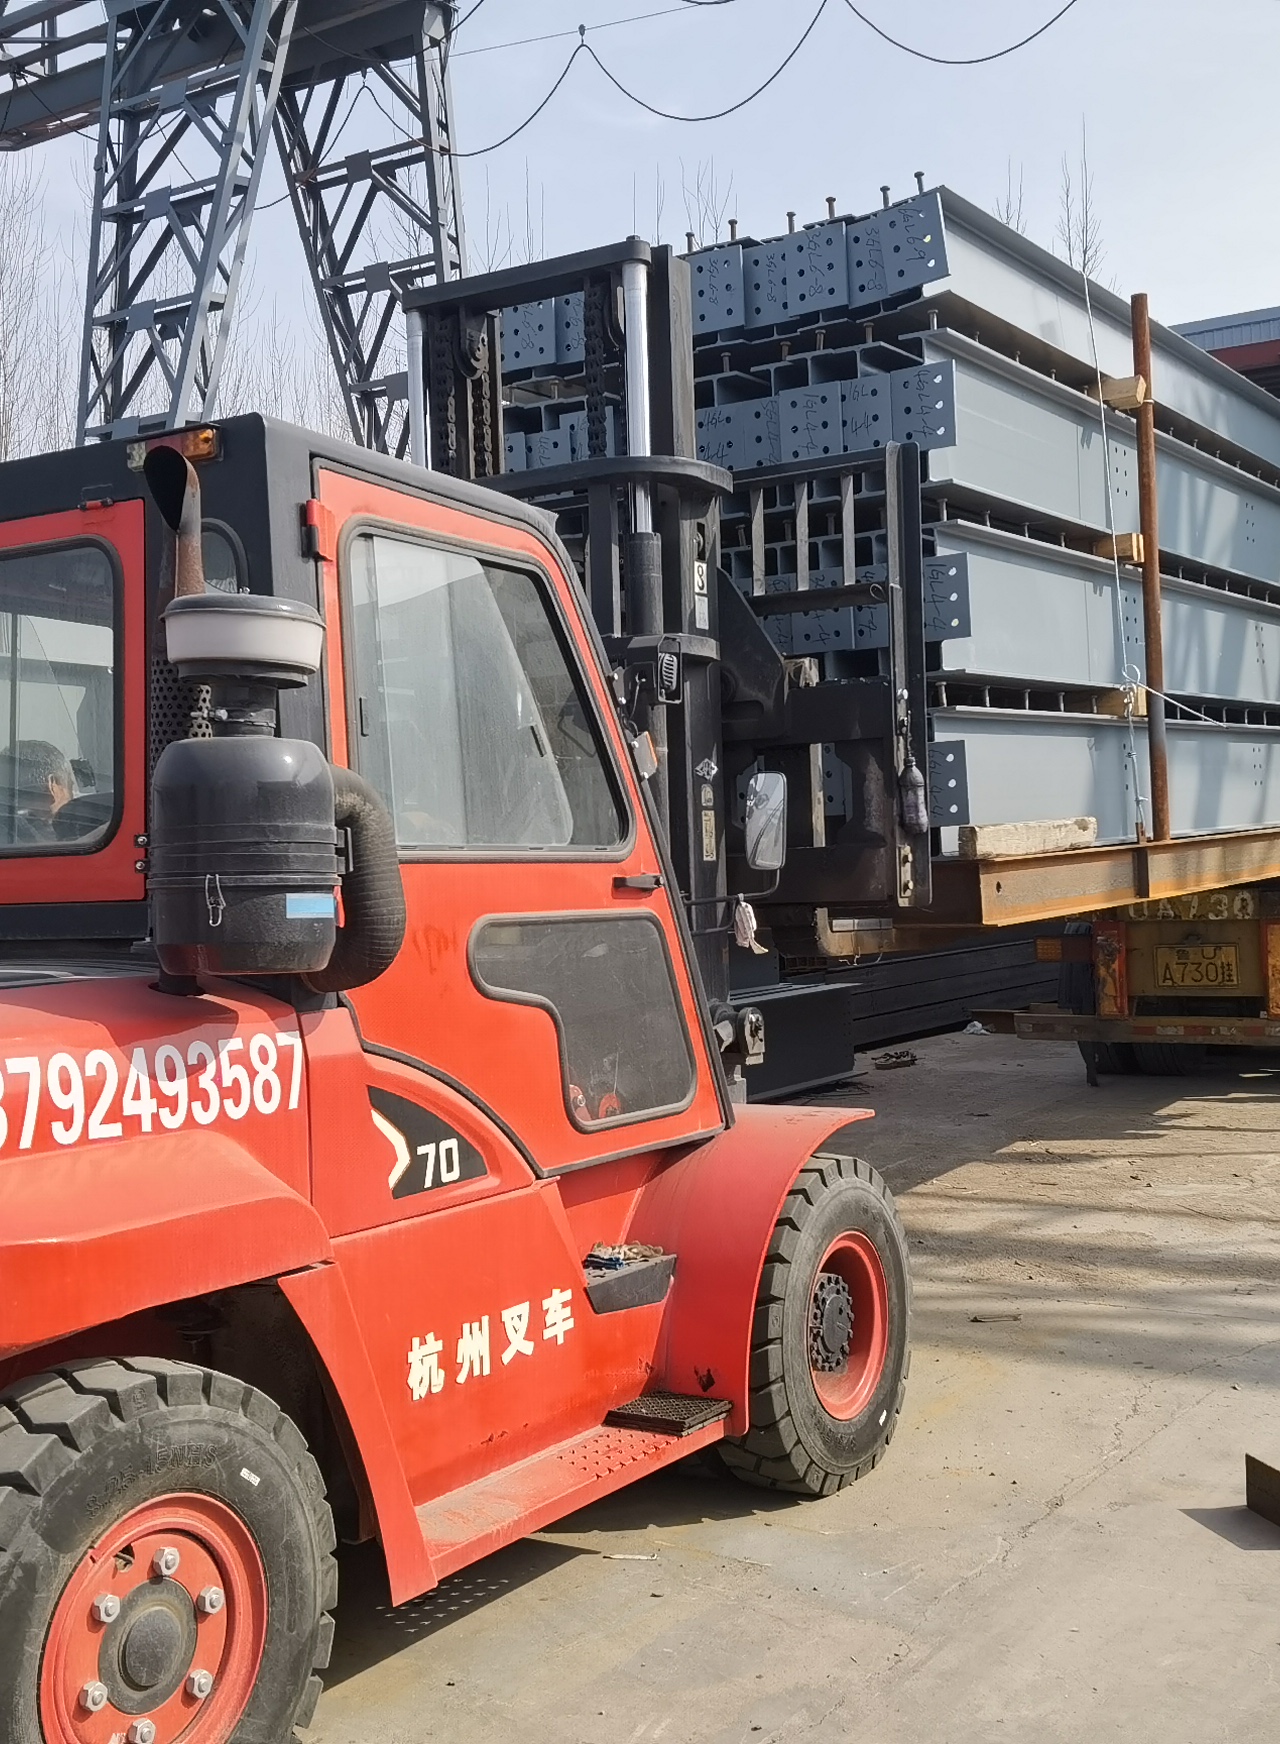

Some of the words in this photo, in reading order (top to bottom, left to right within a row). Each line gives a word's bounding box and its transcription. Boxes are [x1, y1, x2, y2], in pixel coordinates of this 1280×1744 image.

[1162, 961, 1235, 986] A730挂
[416, 1137, 461, 1188] 70
[406, 1287, 576, 1401] 杭州叉车
